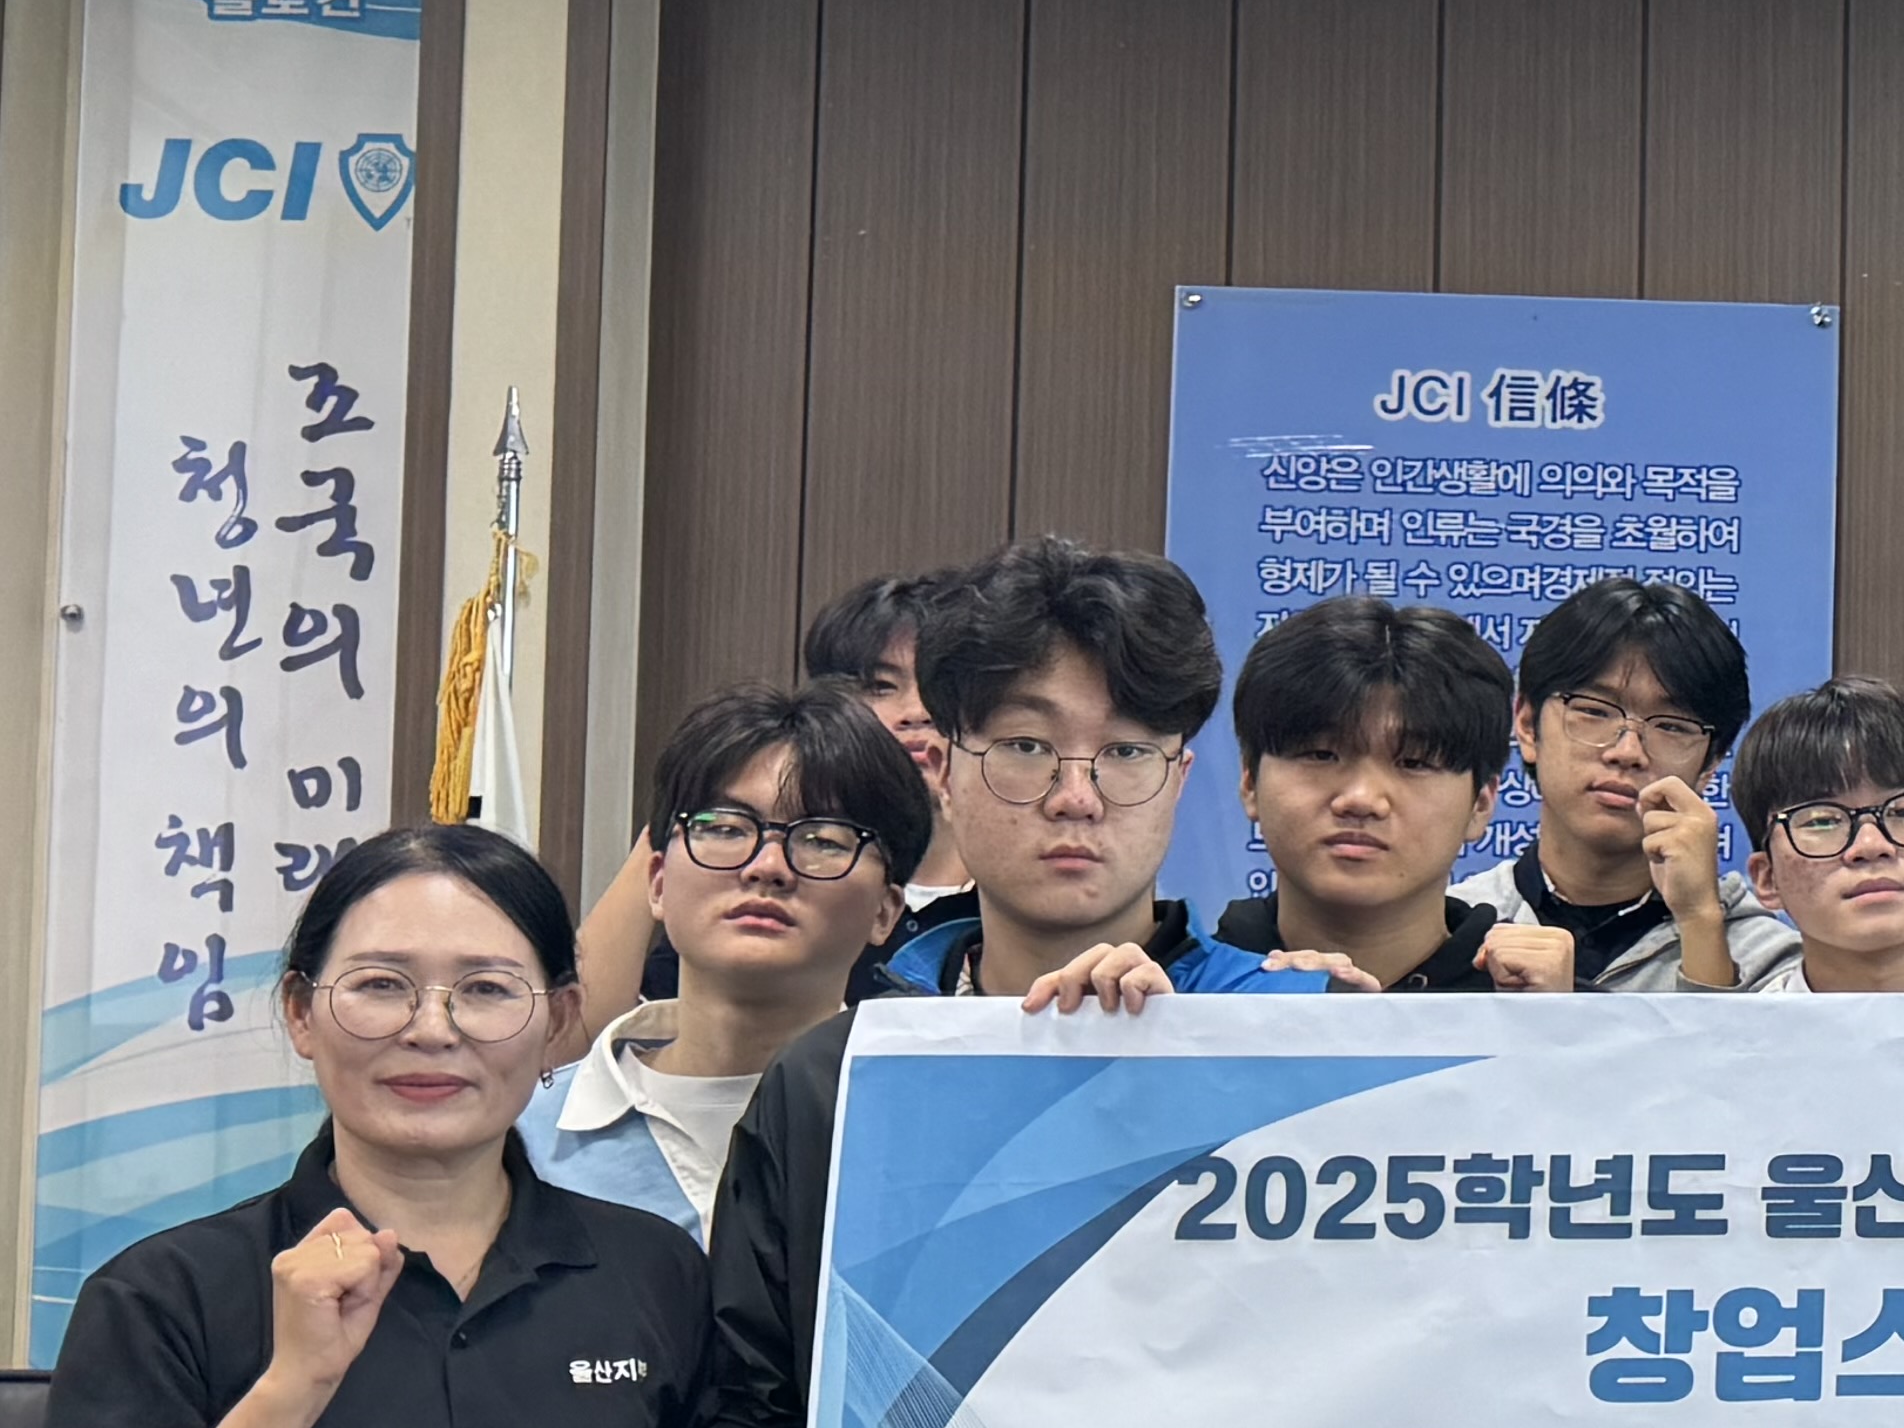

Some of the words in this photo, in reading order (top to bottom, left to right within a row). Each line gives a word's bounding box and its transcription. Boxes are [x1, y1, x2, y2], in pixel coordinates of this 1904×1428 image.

[119, 138, 322, 221] JCI
[1376, 372, 1467, 420] JCI
[1485, 371, 1602, 426] 信條
[1262, 456, 1364, 491] 신앙은
[1371, 457, 1532, 496] 인간생활에
[1538, 463, 1638, 500] 의의와
[1642, 465, 1742, 502] 목적을
[274, 362, 374, 700] 조국의
[1260, 507, 1392, 545] 부여하며
[1402, 510, 1502, 547] 인류는
[1506, 514, 1606, 551] 국경을
[1611, 516, 1741, 553] 초월하여
[170, 435, 262, 769] 청년의
[1259, 558, 1358, 596] 형제가
[1364, 560, 1398, 596] 될
[1404, 562, 1441, 598] 수
[154, 814, 235, 1031] 책임
[1174, 1152, 1730, 1243] 2025학년도
